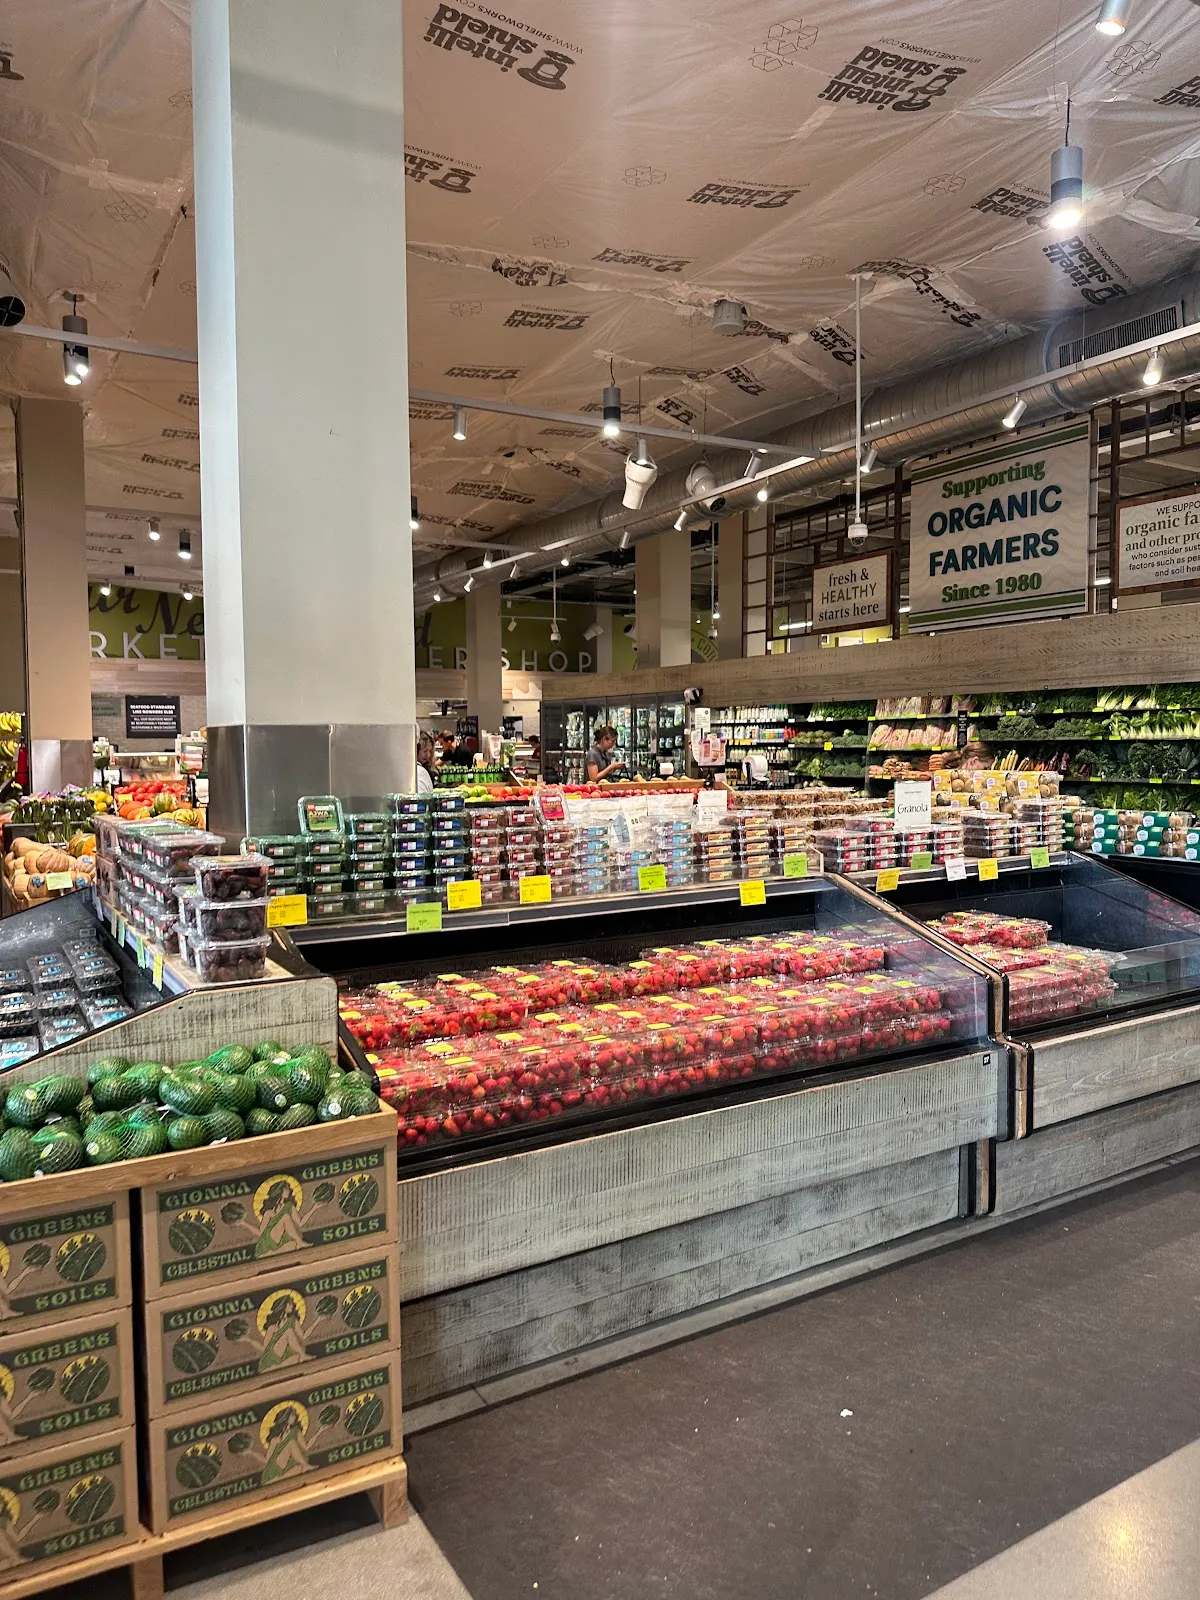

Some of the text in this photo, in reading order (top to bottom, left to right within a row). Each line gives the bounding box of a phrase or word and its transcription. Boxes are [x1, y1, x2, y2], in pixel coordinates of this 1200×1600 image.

[431, 3, 538, 54] shield
[424, 24, 518, 73] intelli
[850, 46, 939, 78] shield
[817, 79, 899, 111] intelli
[942, 459, 1046, 499] Supporting
[927, 485, 1062, 537] ORGANIC
[1156, 506, 1170, 516] WE
[1126, 515, 1180, 537] organic
[929, 528, 1059, 577] FARMERS
[1125, 538, 1146, 551] and
[1149, 535, 1181, 548] other
[1131, 552, 1148, 560] who
[1149, 546, 1183, 557] consider
[828, 567, 870, 587] fresh &
[1129, 561, 1155, 571] factors
[1156, 557, 1175, 567] such
[1154, 569, 1169, 577] and
[1171, 566, 1185, 575] soil
[821, 582, 877, 605] HEALTHY
[942, 572, 1042, 603] Since 1980
[818, 601, 879, 622] starts here
[897, 803, 928, 815] Granola
[302, 1154, 380, 1180] GREENS
[166, 1181, 251, 1208] GIONNA
[9, 1211, 107, 1241] GREENS
[323, 1218, 380, 1242] SOILS
[166, 1249, 251, 1277] CELESTIAL
[305, 1264, 383, 1293] GREENS
[35, 1283, 108, 1311] SOILS
[170, 1297, 255, 1327] GIONNA
[14, 1333, 110, 1366] GREENS
[326, 1328, 383, 1353] SOILS
[170, 1366, 254, 1396] CELESTIAL
[308, 1374, 385, 1404] GREENS
[39, 1402, 112, 1434] SOILS
[173, 1411, 258, 1443] GIONNA
[328, 1436, 385, 1463] SOILS
[20, 1451, 115, 1490] GREENS
[173, 1477, 258, 1512] CELESTIAL
[45, 1521, 117, 1554] SOILS
